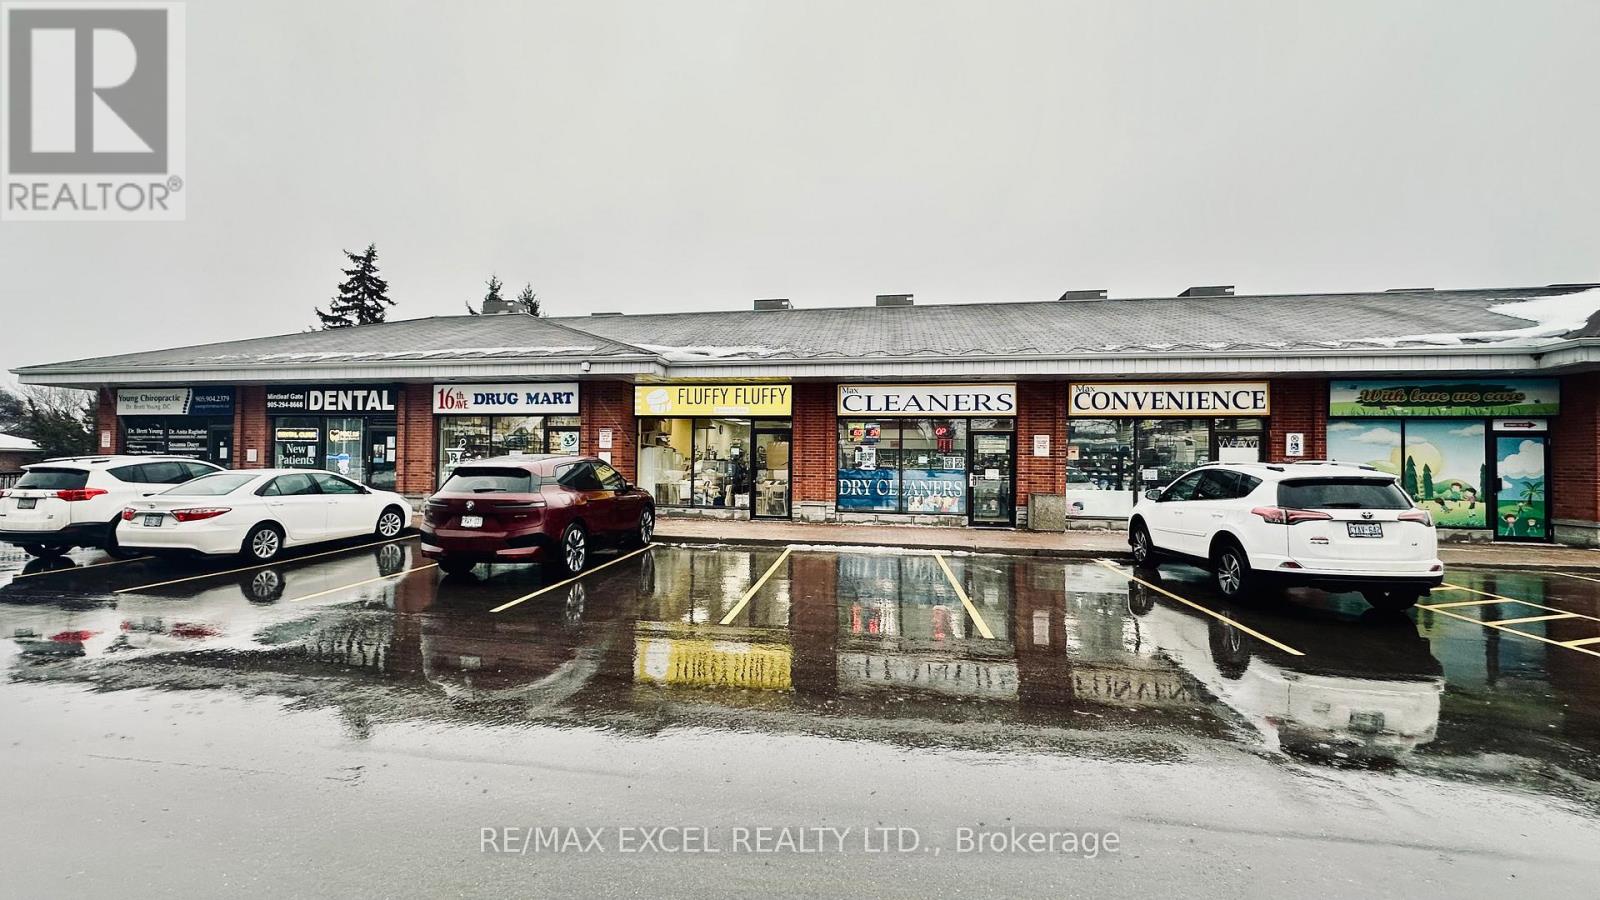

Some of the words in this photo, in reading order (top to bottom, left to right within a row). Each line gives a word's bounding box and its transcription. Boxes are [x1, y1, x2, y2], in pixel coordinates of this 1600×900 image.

[119, 395, 138, 403] Young
[140, 393, 181, 402] Chiropractic
[678, 388, 729, 405] FLUFFY
[735, 387, 787, 405] FLUFFY
[1075, 385, 1096, 393] Max
[1360, 388, 1407, 402] With
[1409, 388, 1450, 402] love
[1451, 391, 1481, 402] we
[1482, 391, 1526, 402] care
[309, 390, 395, 411] DENTAL
[455, 400, 468, 409] AVE
[473, 392, 519, 405] DRUG
[525, 391, 574, 405] MART
[842, 393, 1013, 412] CLEANERS
[1074, 390, 1266, 410] CONVENIENCE
[286, 444, 307, 454] New
[277, 454, 315, 465] Patients
[838, 479, 872, 496] DRY
[876, 479, 963, 497] CLEANERS
